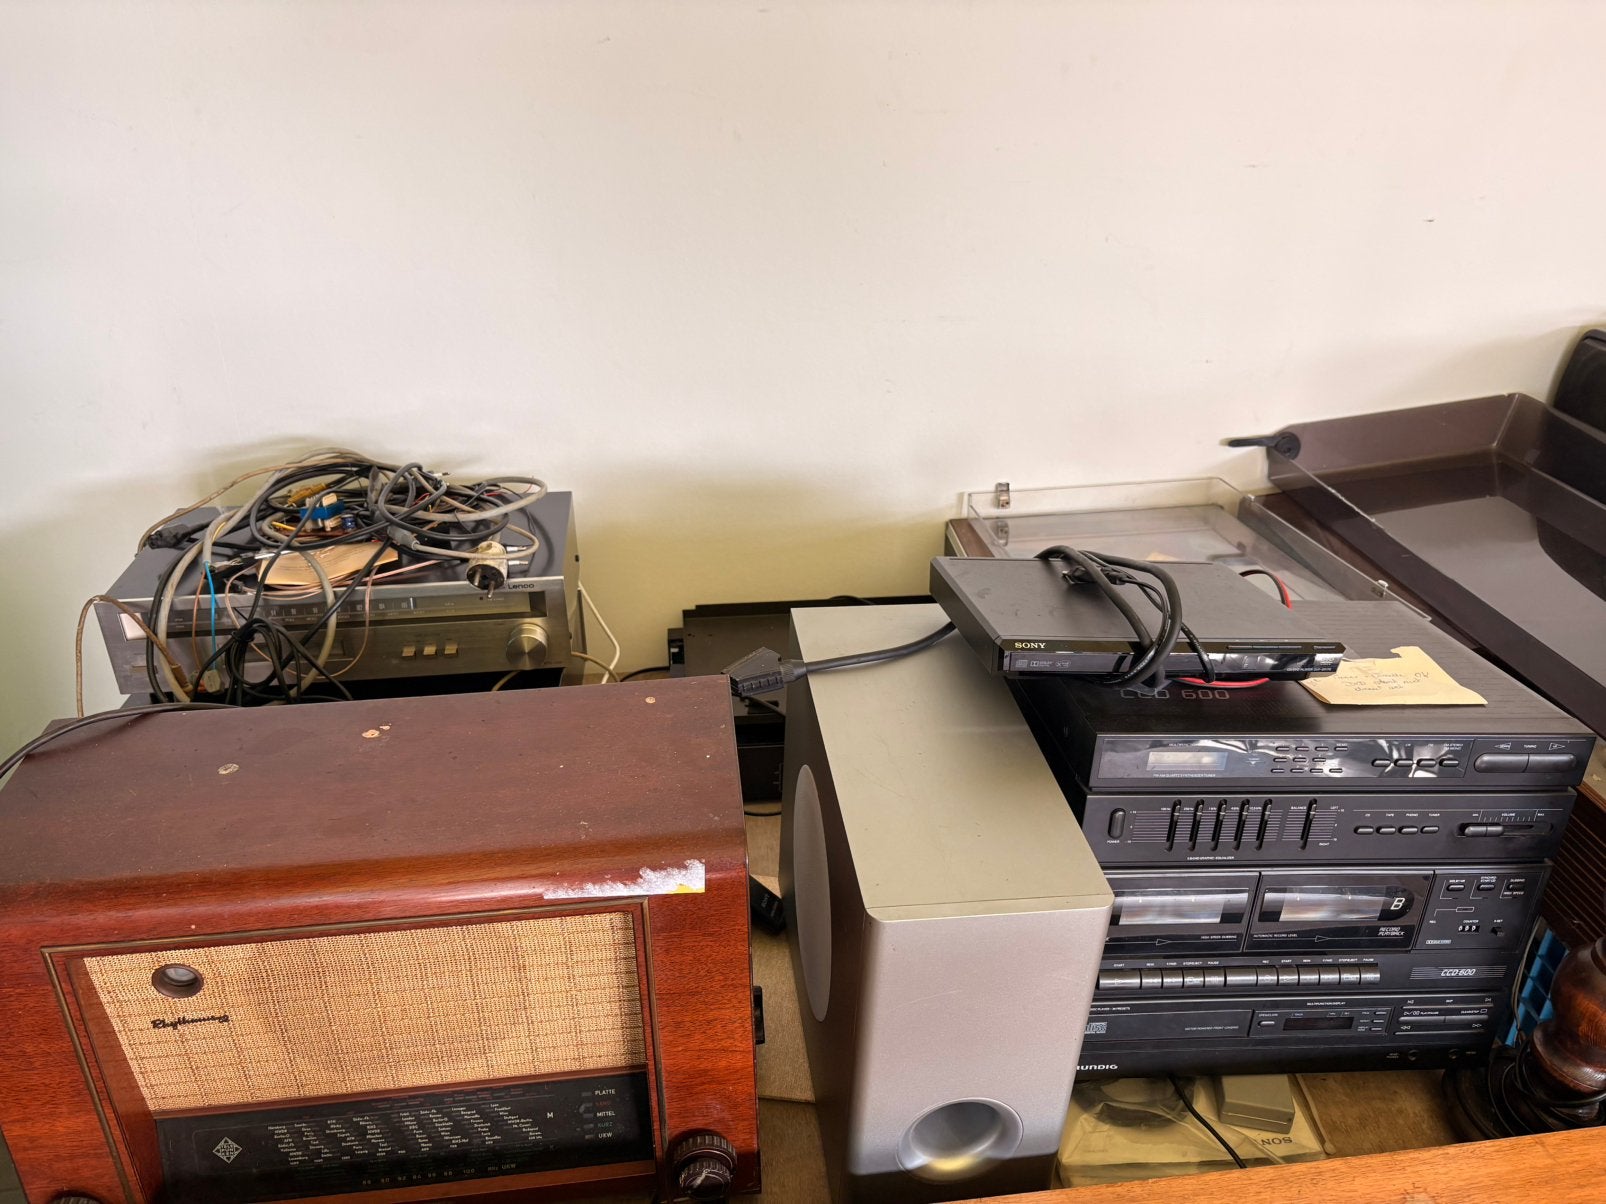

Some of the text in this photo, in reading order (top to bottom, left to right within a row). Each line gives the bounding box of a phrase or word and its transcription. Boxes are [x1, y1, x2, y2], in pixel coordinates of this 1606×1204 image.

[1181, 689, 1231, 700] 600
[1390, 897, 1406, 910] B
[1440, 968, 1477, 977] CCD 600
[546, 1111, 554, 1119] M
[596, 1110, 616, 1118] MITTEL
[1254, 1135, 1293, 1146] SON
